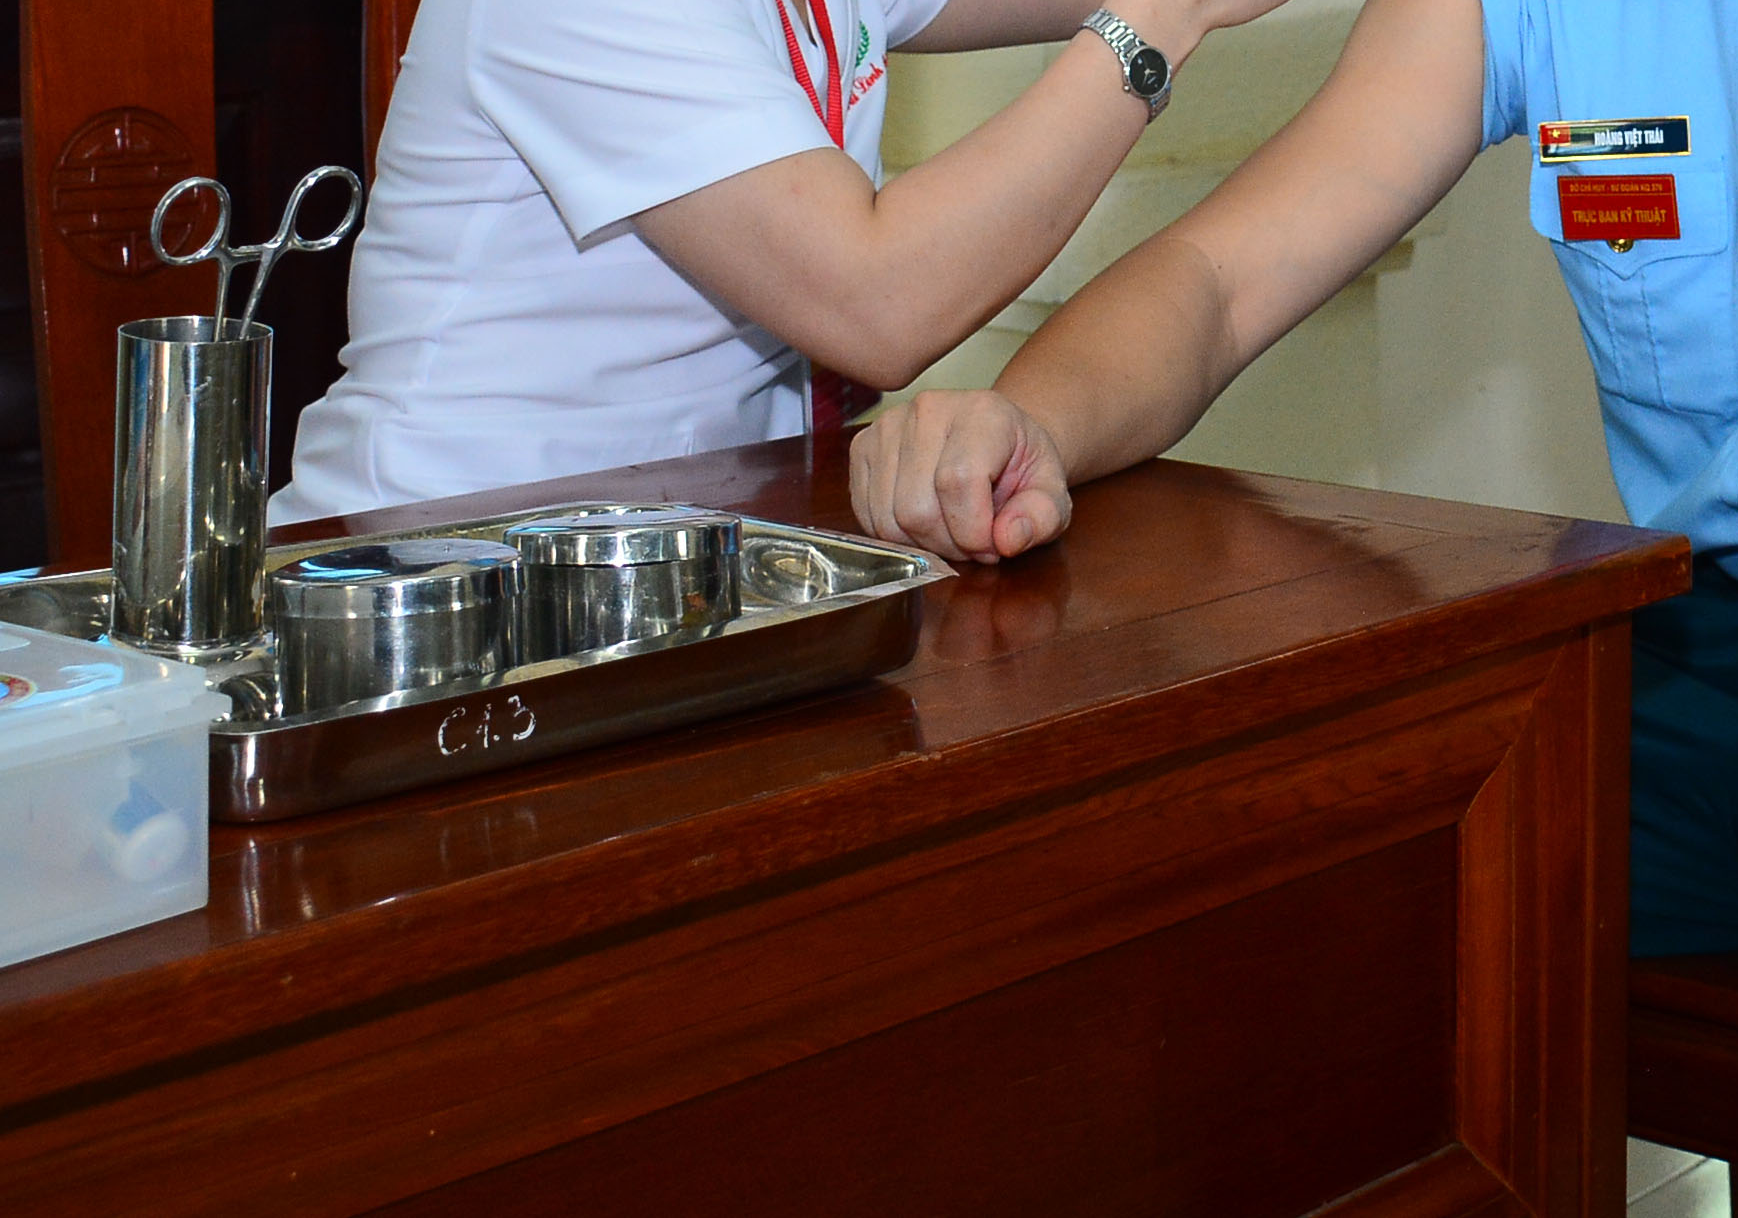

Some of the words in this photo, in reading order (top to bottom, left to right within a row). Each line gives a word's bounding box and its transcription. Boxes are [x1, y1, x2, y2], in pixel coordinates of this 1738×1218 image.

[1624, 127, 1643, 148] VIỆT
[1644, 126, 1664, 145] THÁI
[1634, 206, 1667, 226] THUẬT
